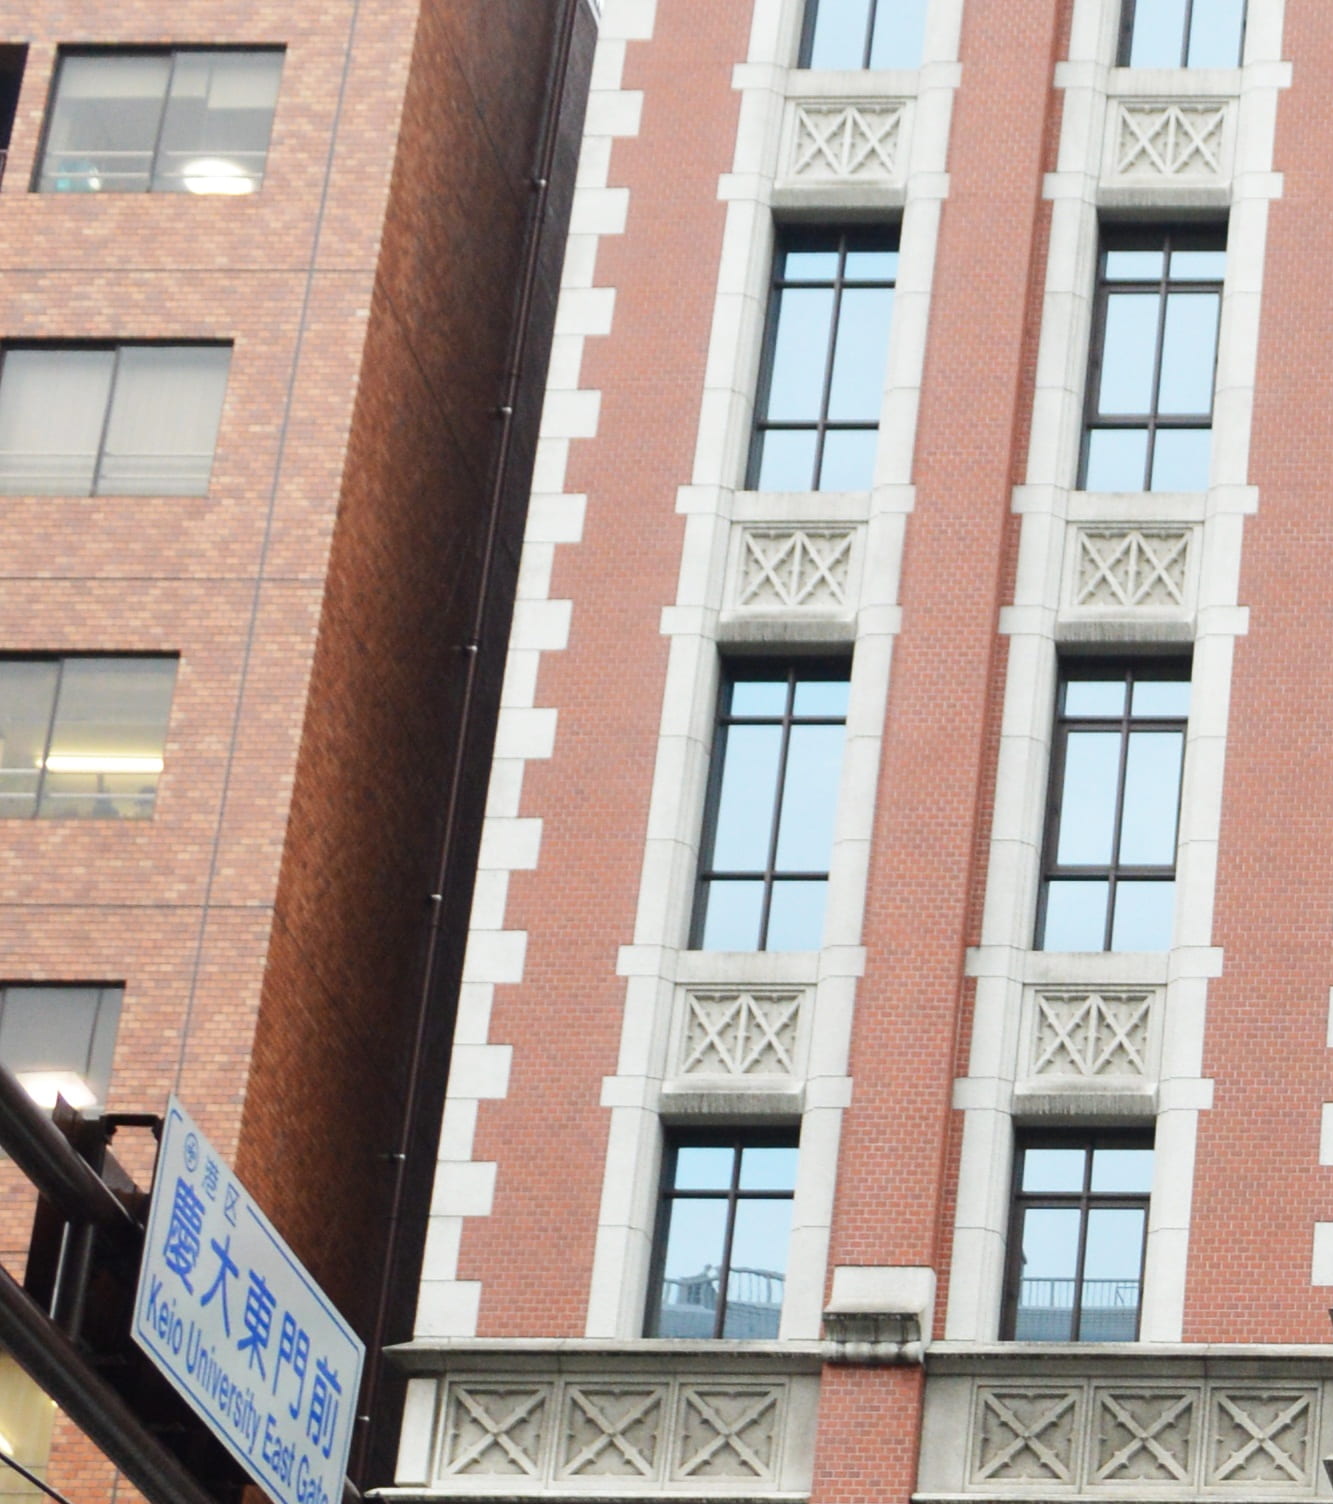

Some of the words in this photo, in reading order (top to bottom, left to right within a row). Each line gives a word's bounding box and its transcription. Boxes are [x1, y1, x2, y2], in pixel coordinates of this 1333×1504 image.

[200, 1154, 241, 1228] 港区
[147, 1272, 184, 1356] Keio
[184, 1320, 262, 1455] University
[261, 1412, 297, 1488] East
[162, 1175, 343, 1460] 慶大東門前
